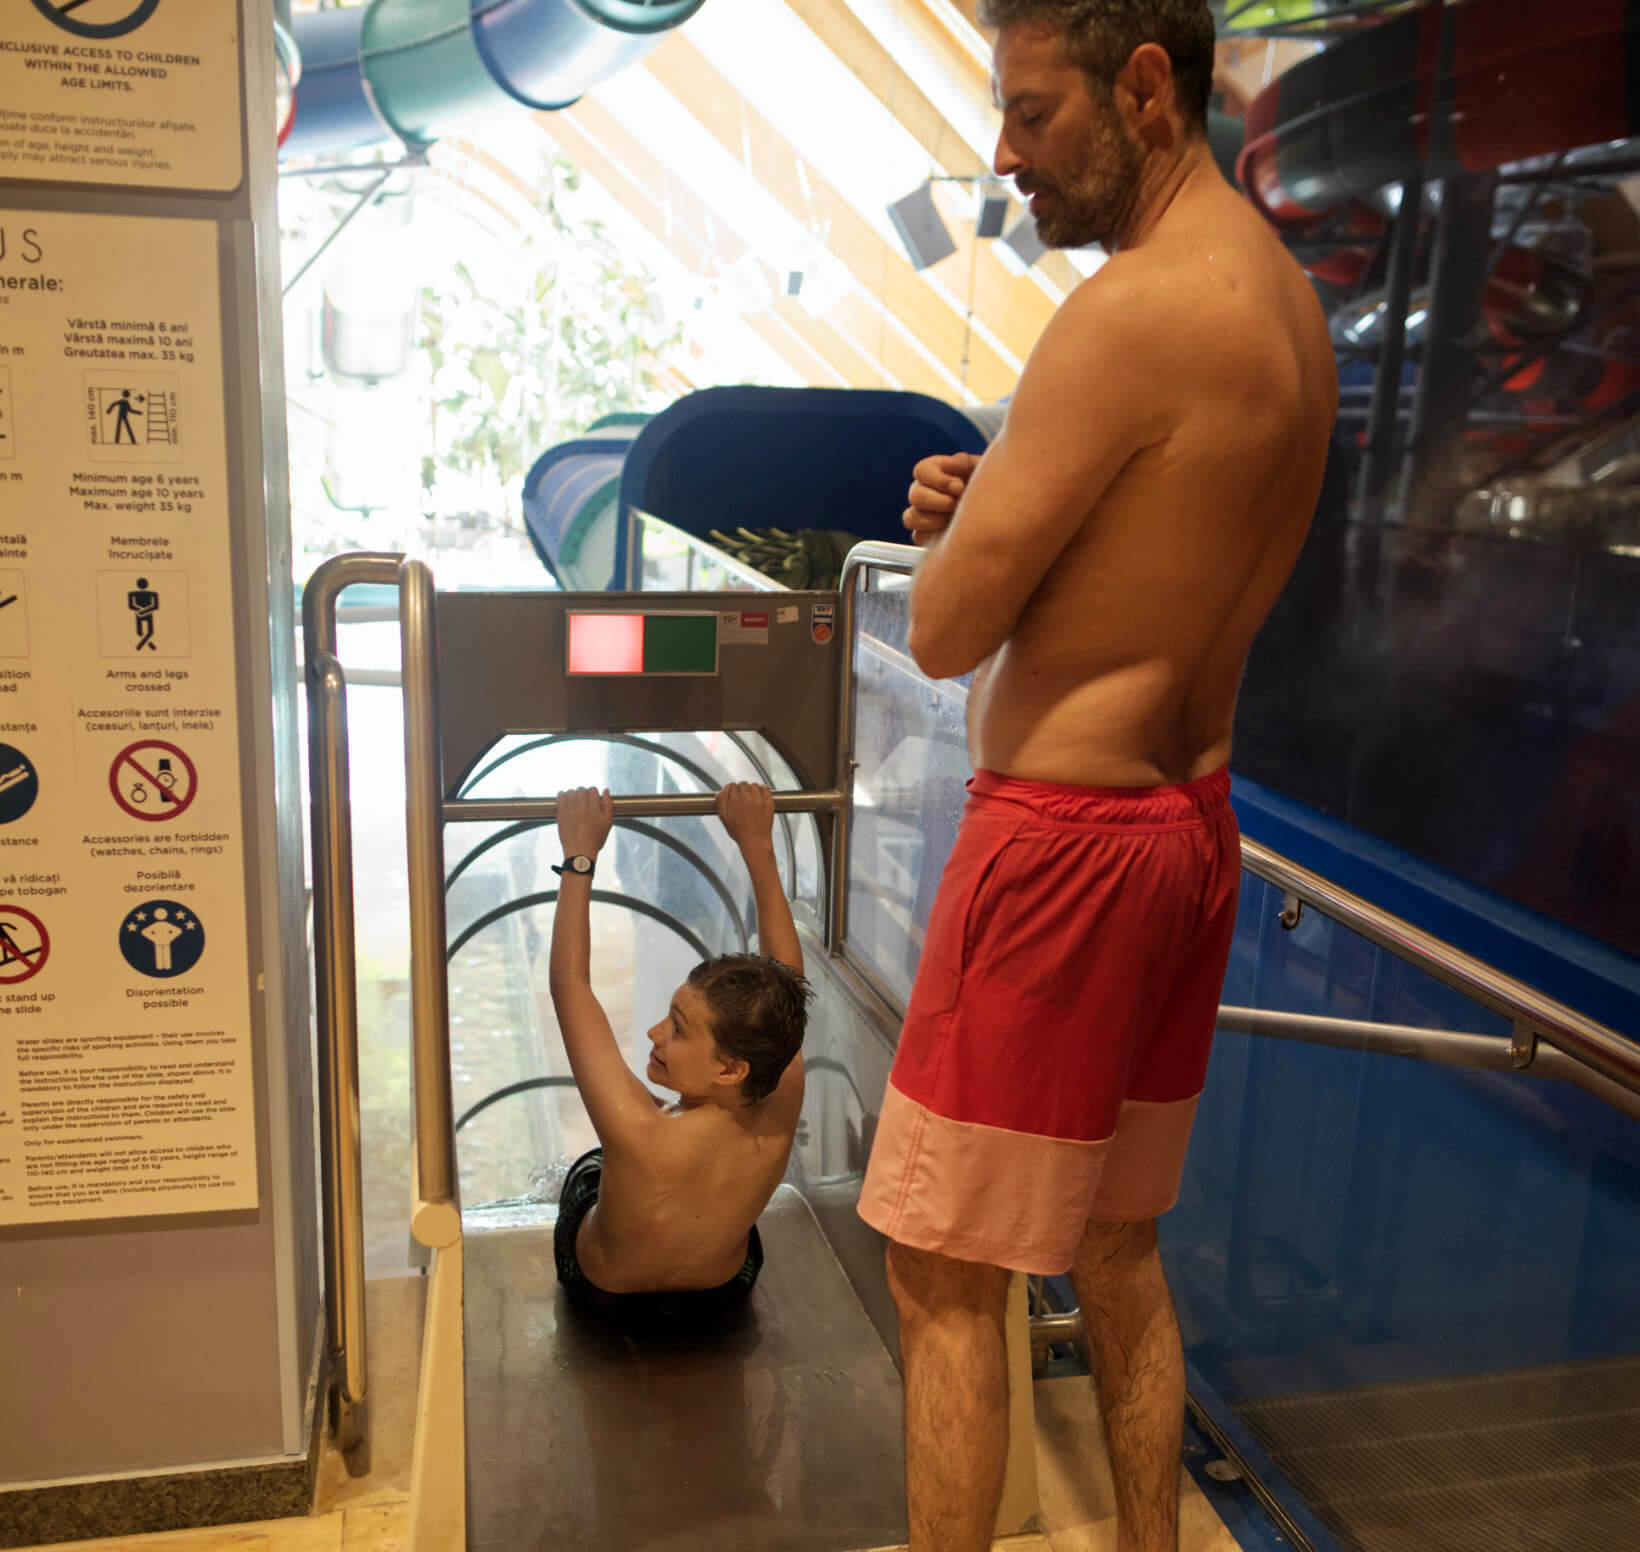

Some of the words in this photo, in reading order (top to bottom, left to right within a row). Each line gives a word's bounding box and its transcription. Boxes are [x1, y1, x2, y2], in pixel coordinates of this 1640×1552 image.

[64, 46, 112, 59] ACCESS
[116, 50, 133, 60] TO
[137, 51, 200, 66] CHILDREN
[24, 58, 72, 71] WITHIN
[76, 62, 100, 73] THE
[104, 64, 167, 79] ALLOWED
[60, 77, 86, 88] AGE
[90, 79, 134, 91] LIMITS.
[30, 112, 77, 122] conform
[30, 124, 57, 133] duce
[60, 126, 70, 135] la
[13, 138, 25, 148] of
[54, 142, 90, 154] height
[93, 145, 114, 154] and
[22, 153, 46, 164] may
[50, 154, 86, 164] attract
[90, 157, 129, 167] serious
[158, 321, 168, 332] 6
[170, 322, 188, 334] ani
[158, 336, 172, 347] 10
[174, 337, 192, 348] ani
[12, 346, 24, 356] m
[63, 346, 126, 360] Greutatea
[128, 350, 158, 361] max.
[161, 350, 176, 361] 35
[179, 350, 194, 363] kg
[10, 472, 24, 481] m
[72, 472, 129, 484] Minimum
[131, 475, 154, 486] age
[156, 474, 166, 484] 6
[168, 476, 200, 487] years
[69, 486, 128, 498] Maximum
[131, 488, 154, 500] age
[156, 487, 170, 498] 10
[172, 489, 204, 500] years
[84, 500, 111, 512] Max.
[114, 501, 156, 514] weight
[159, 501, 175, 512] 35
[177, 502, 192, 514] kg
[110, 535, 170, 547] Membrele
[106, 669, 137, 680] Arms
[140, 670, 162, 680] and
[164, 669, 190, 682] legs
[126, 682, 172, 692] crossed
[77, 708, 142, 718] Accesoriile
[145, 708, 170, 718] sunt
[173, 707, 222, 718] interzise
[182, 720, 214, 731] inele)
[82, 834, 151, 846] Accessories
[153, 835, 173, 844] are
[174, 832, 230, 844] forbidden
[90, 847, 146, 858] (watches,
[148, 846, 188, 856] chains,
[191, 844, 224, 856] rings)
[17, 884, 68, 897] tobogan
[123, 882, 196, 893] dezorientare
[6, 990, 38, 1002] stand
[40, 992, 56, 1003] up
[126, 986, 205, 998] Disorientation
[15, 1003, 42, 1014] slide
[143, 999, 190, 1010] possible
